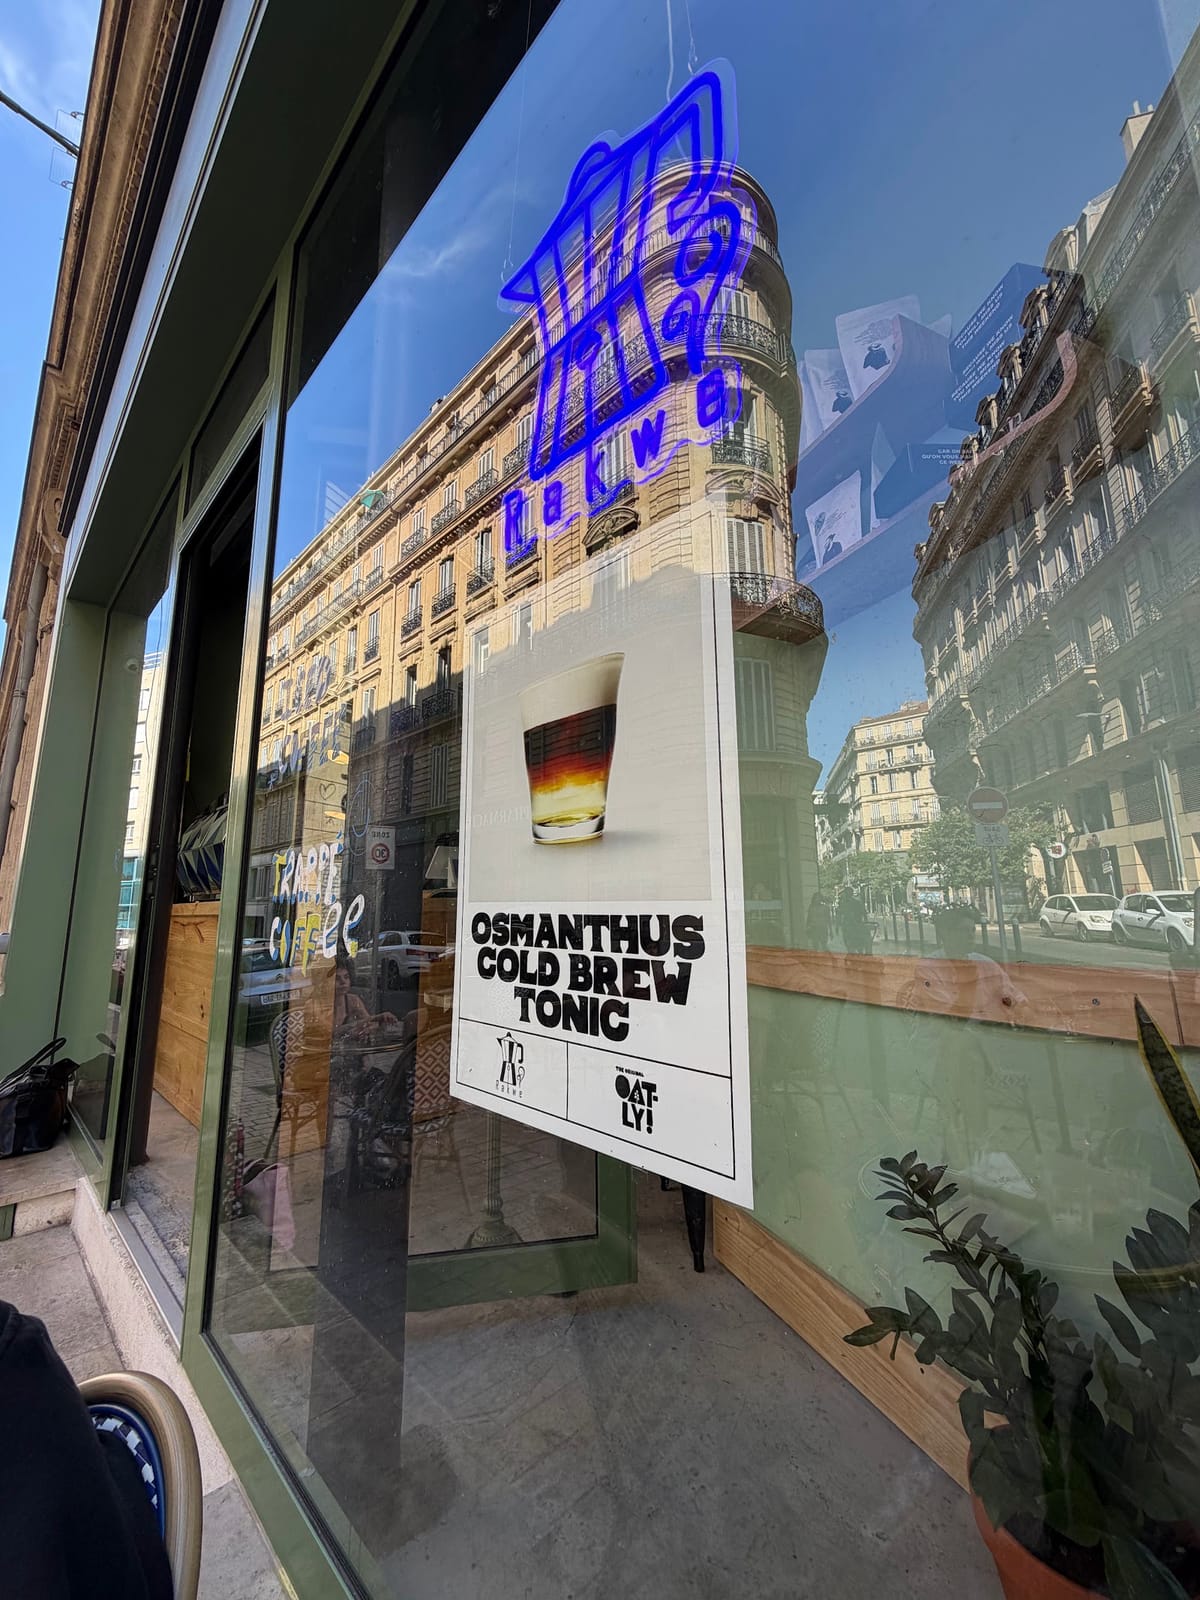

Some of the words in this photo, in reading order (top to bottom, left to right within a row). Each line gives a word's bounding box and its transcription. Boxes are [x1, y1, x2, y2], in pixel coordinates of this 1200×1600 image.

[471, 912, 706, 960] OSMANTHUS
[477, 946, 561, 986] COLD
[567, 953, 692, 1006] BREW
[513, 985, 630, 1042] TONIC
[621, 1101, 654, 1135] LY!
